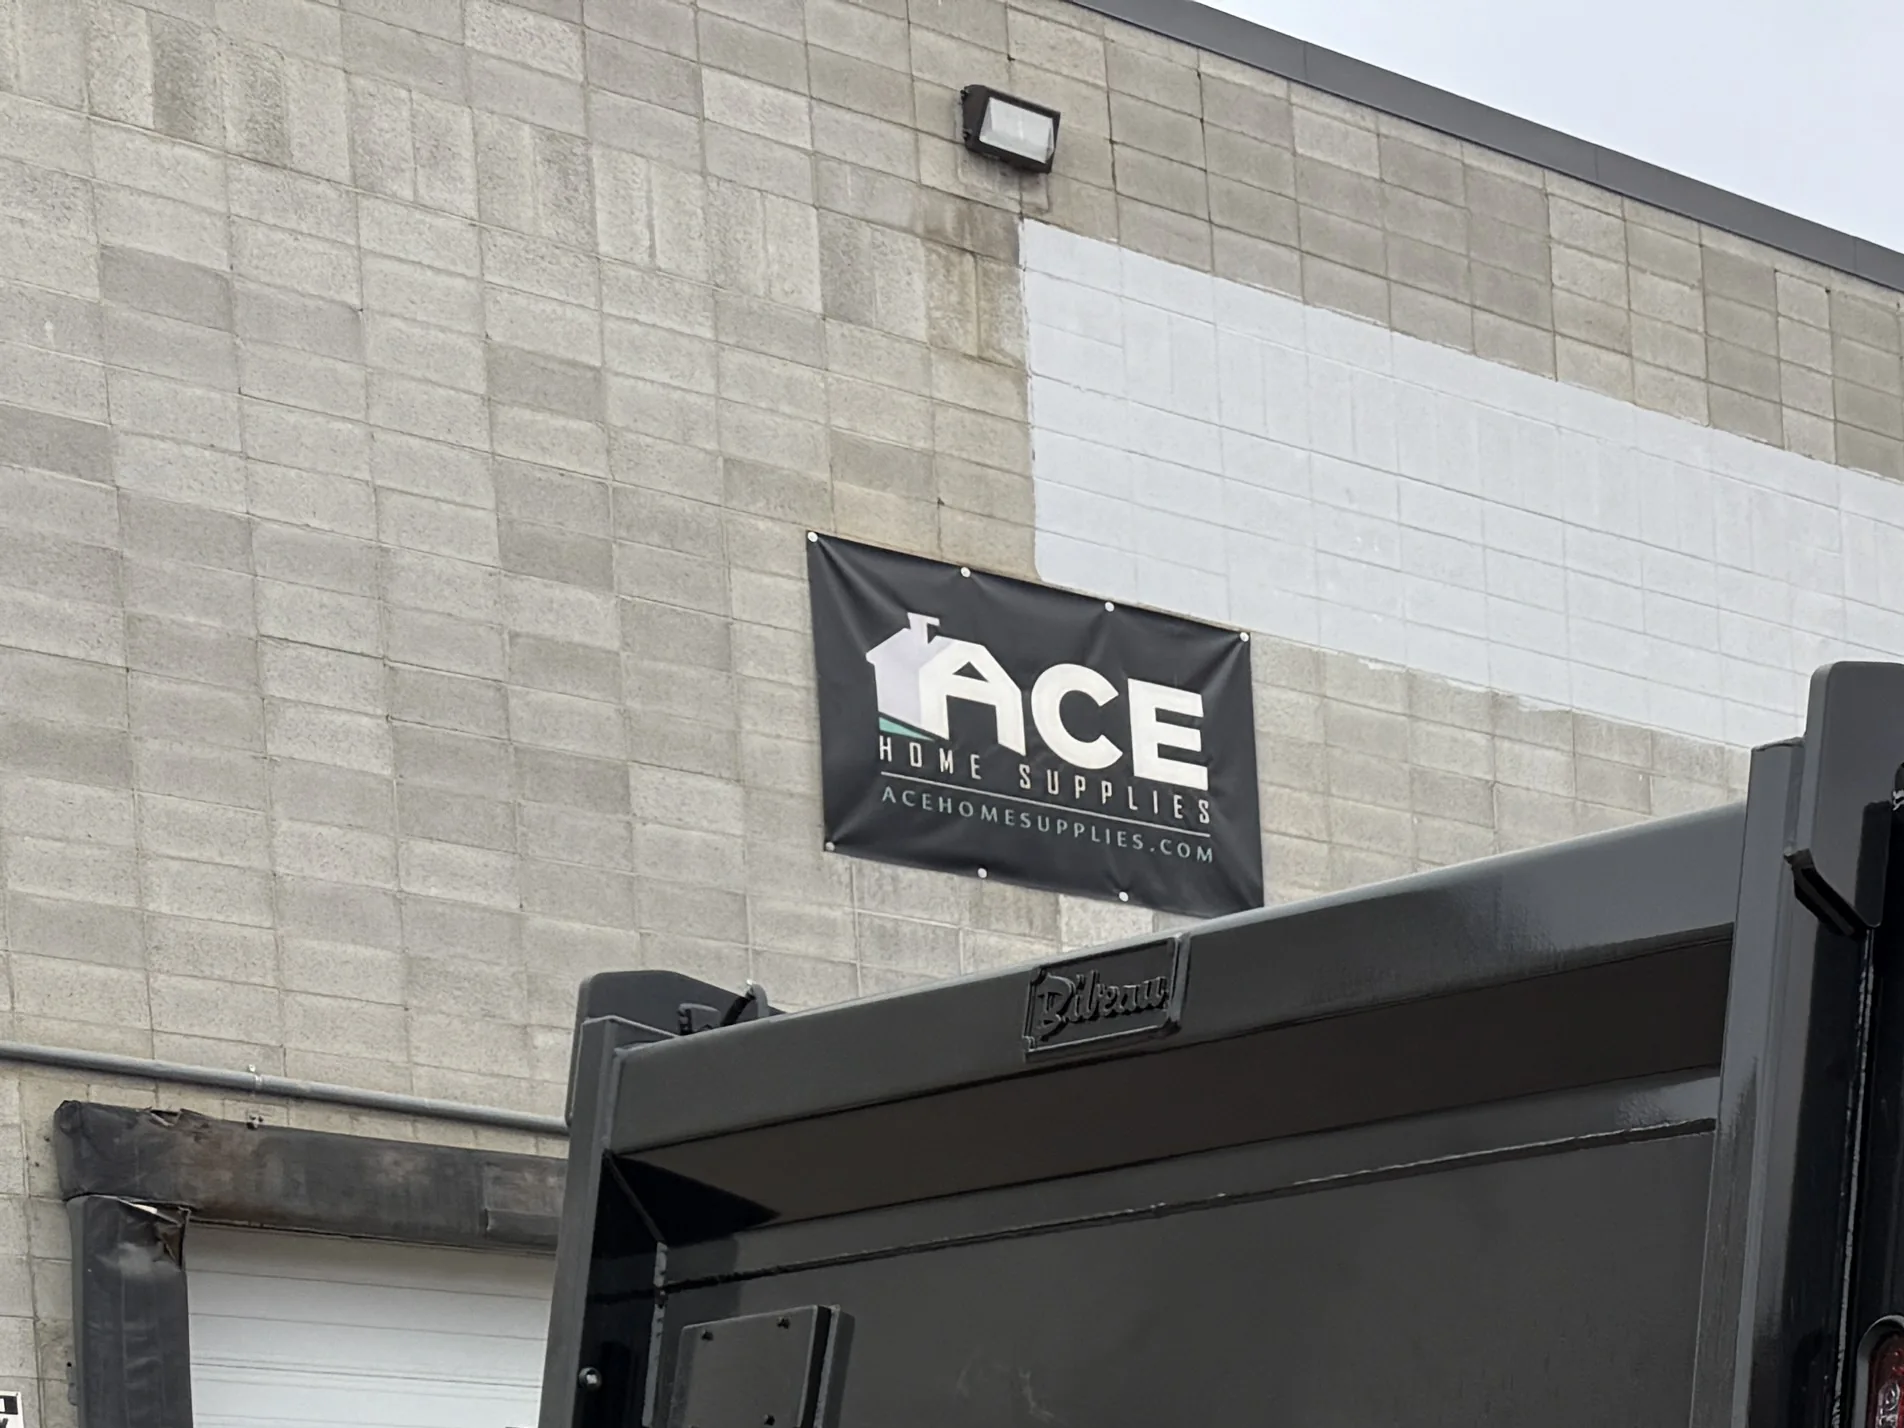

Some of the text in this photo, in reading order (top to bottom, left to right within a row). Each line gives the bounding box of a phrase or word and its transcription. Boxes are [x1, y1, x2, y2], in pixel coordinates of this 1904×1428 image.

[919, 636, 1209, 790] ACE
[879, 735, 1211, 825] HOME SUPPLIES
[881, 785, 1214, 864] ACEHOMESUPPLIES.COM
